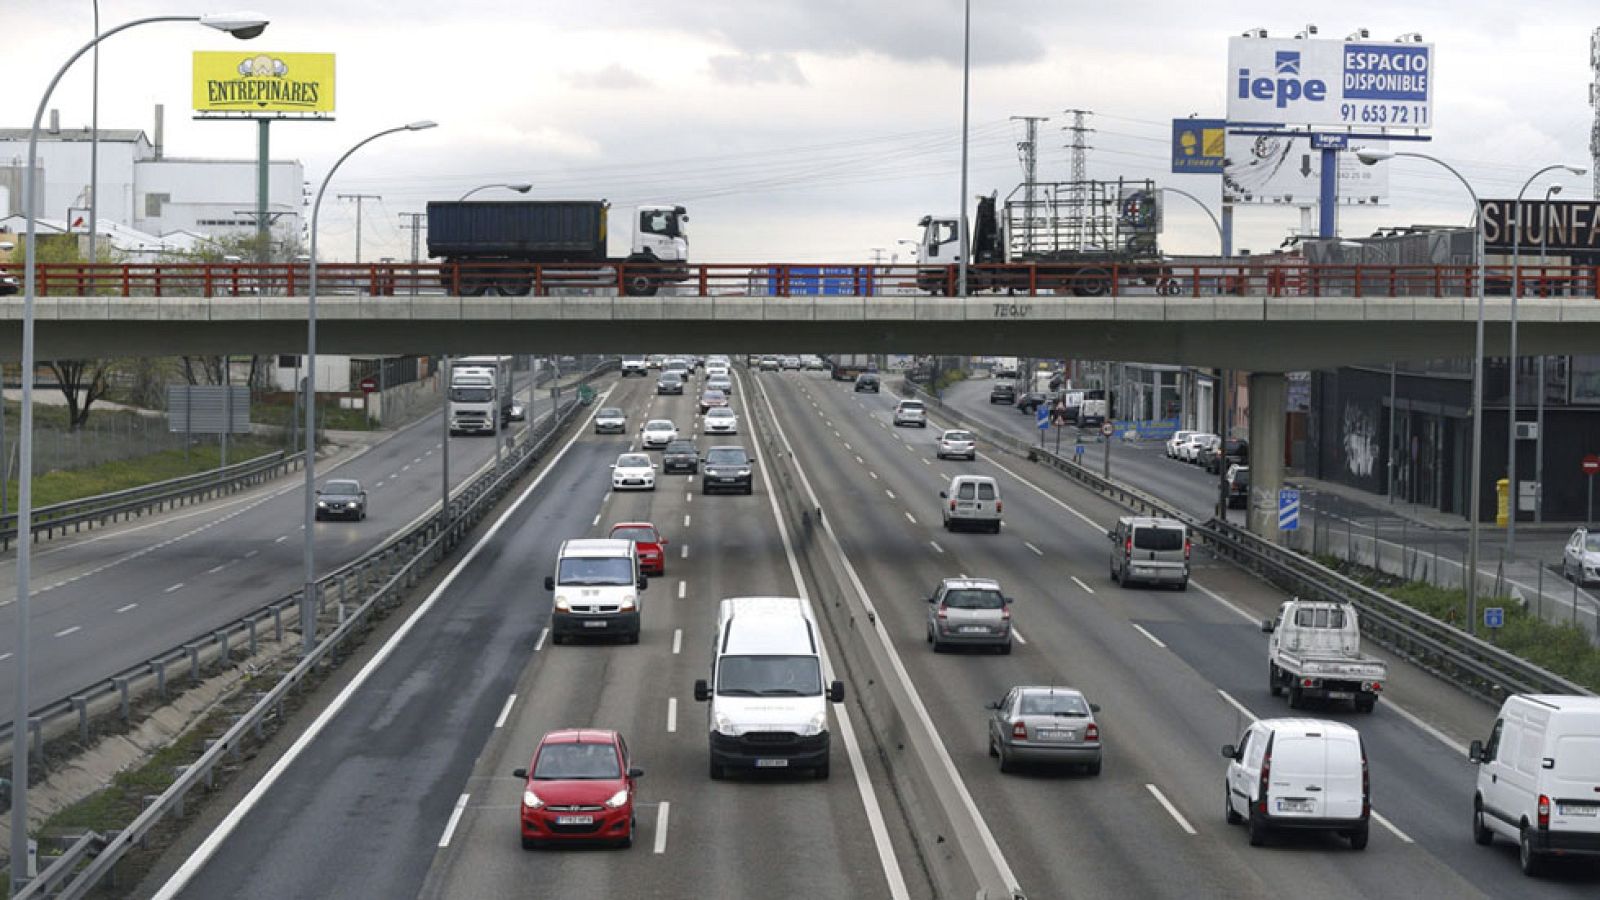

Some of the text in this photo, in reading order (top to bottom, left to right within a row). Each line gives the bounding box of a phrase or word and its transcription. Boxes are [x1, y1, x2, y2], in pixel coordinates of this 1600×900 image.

[1345, 52, 1427, 72] ESPACIO
[207, 79, 320, 103] ENTREPINARES
[1238, 68, 1327, 108] iepe
[1344, 73, 1426, 92] DISPONIBLE
[1341, 103, 1427, 123] 91 653 72 11
